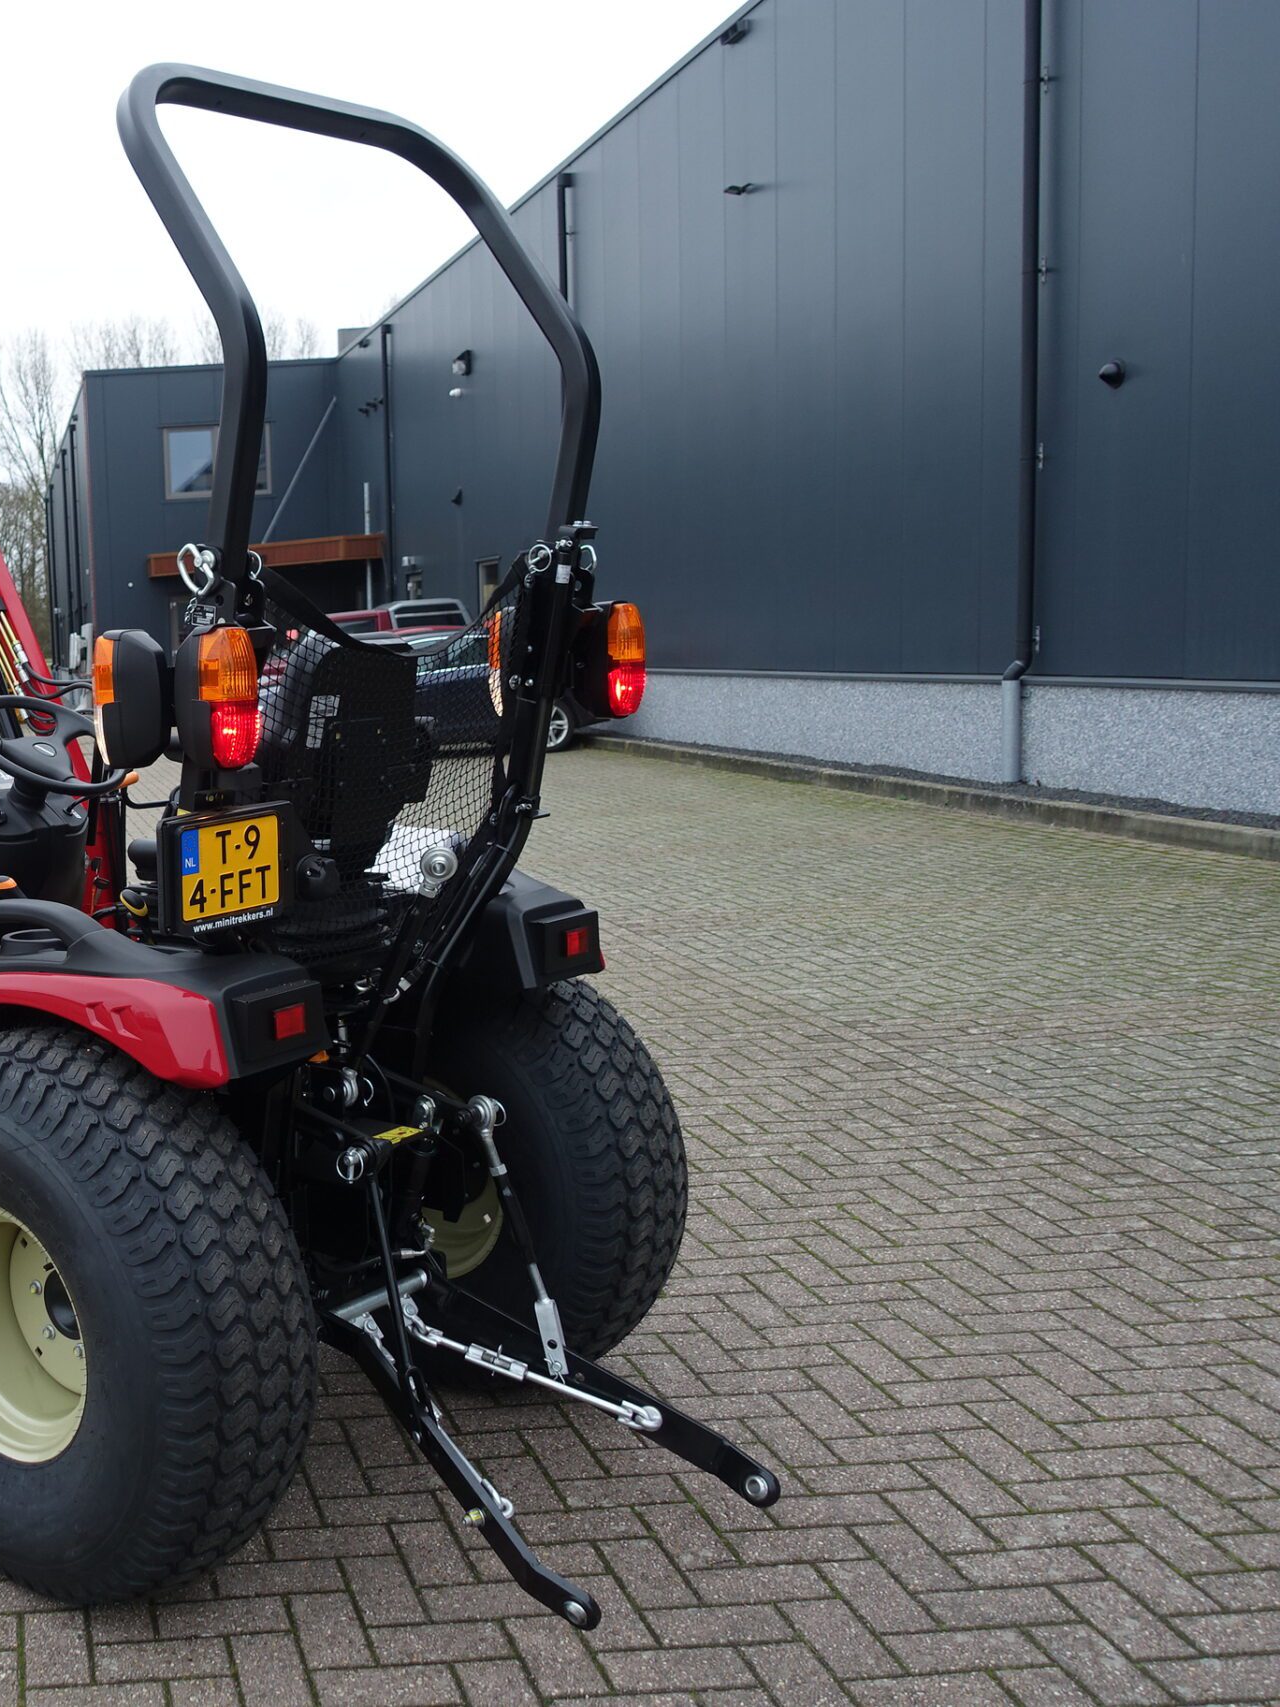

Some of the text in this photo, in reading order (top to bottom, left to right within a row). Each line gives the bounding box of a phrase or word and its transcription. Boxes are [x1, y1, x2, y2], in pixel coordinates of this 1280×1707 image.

[215, 824, 261, 865] T-9
[184, 857, 197, 868] NL
[189, 865, 271, 914] 4-FFT
[193, 907, 274, 933] www.minitrekkers.nl
